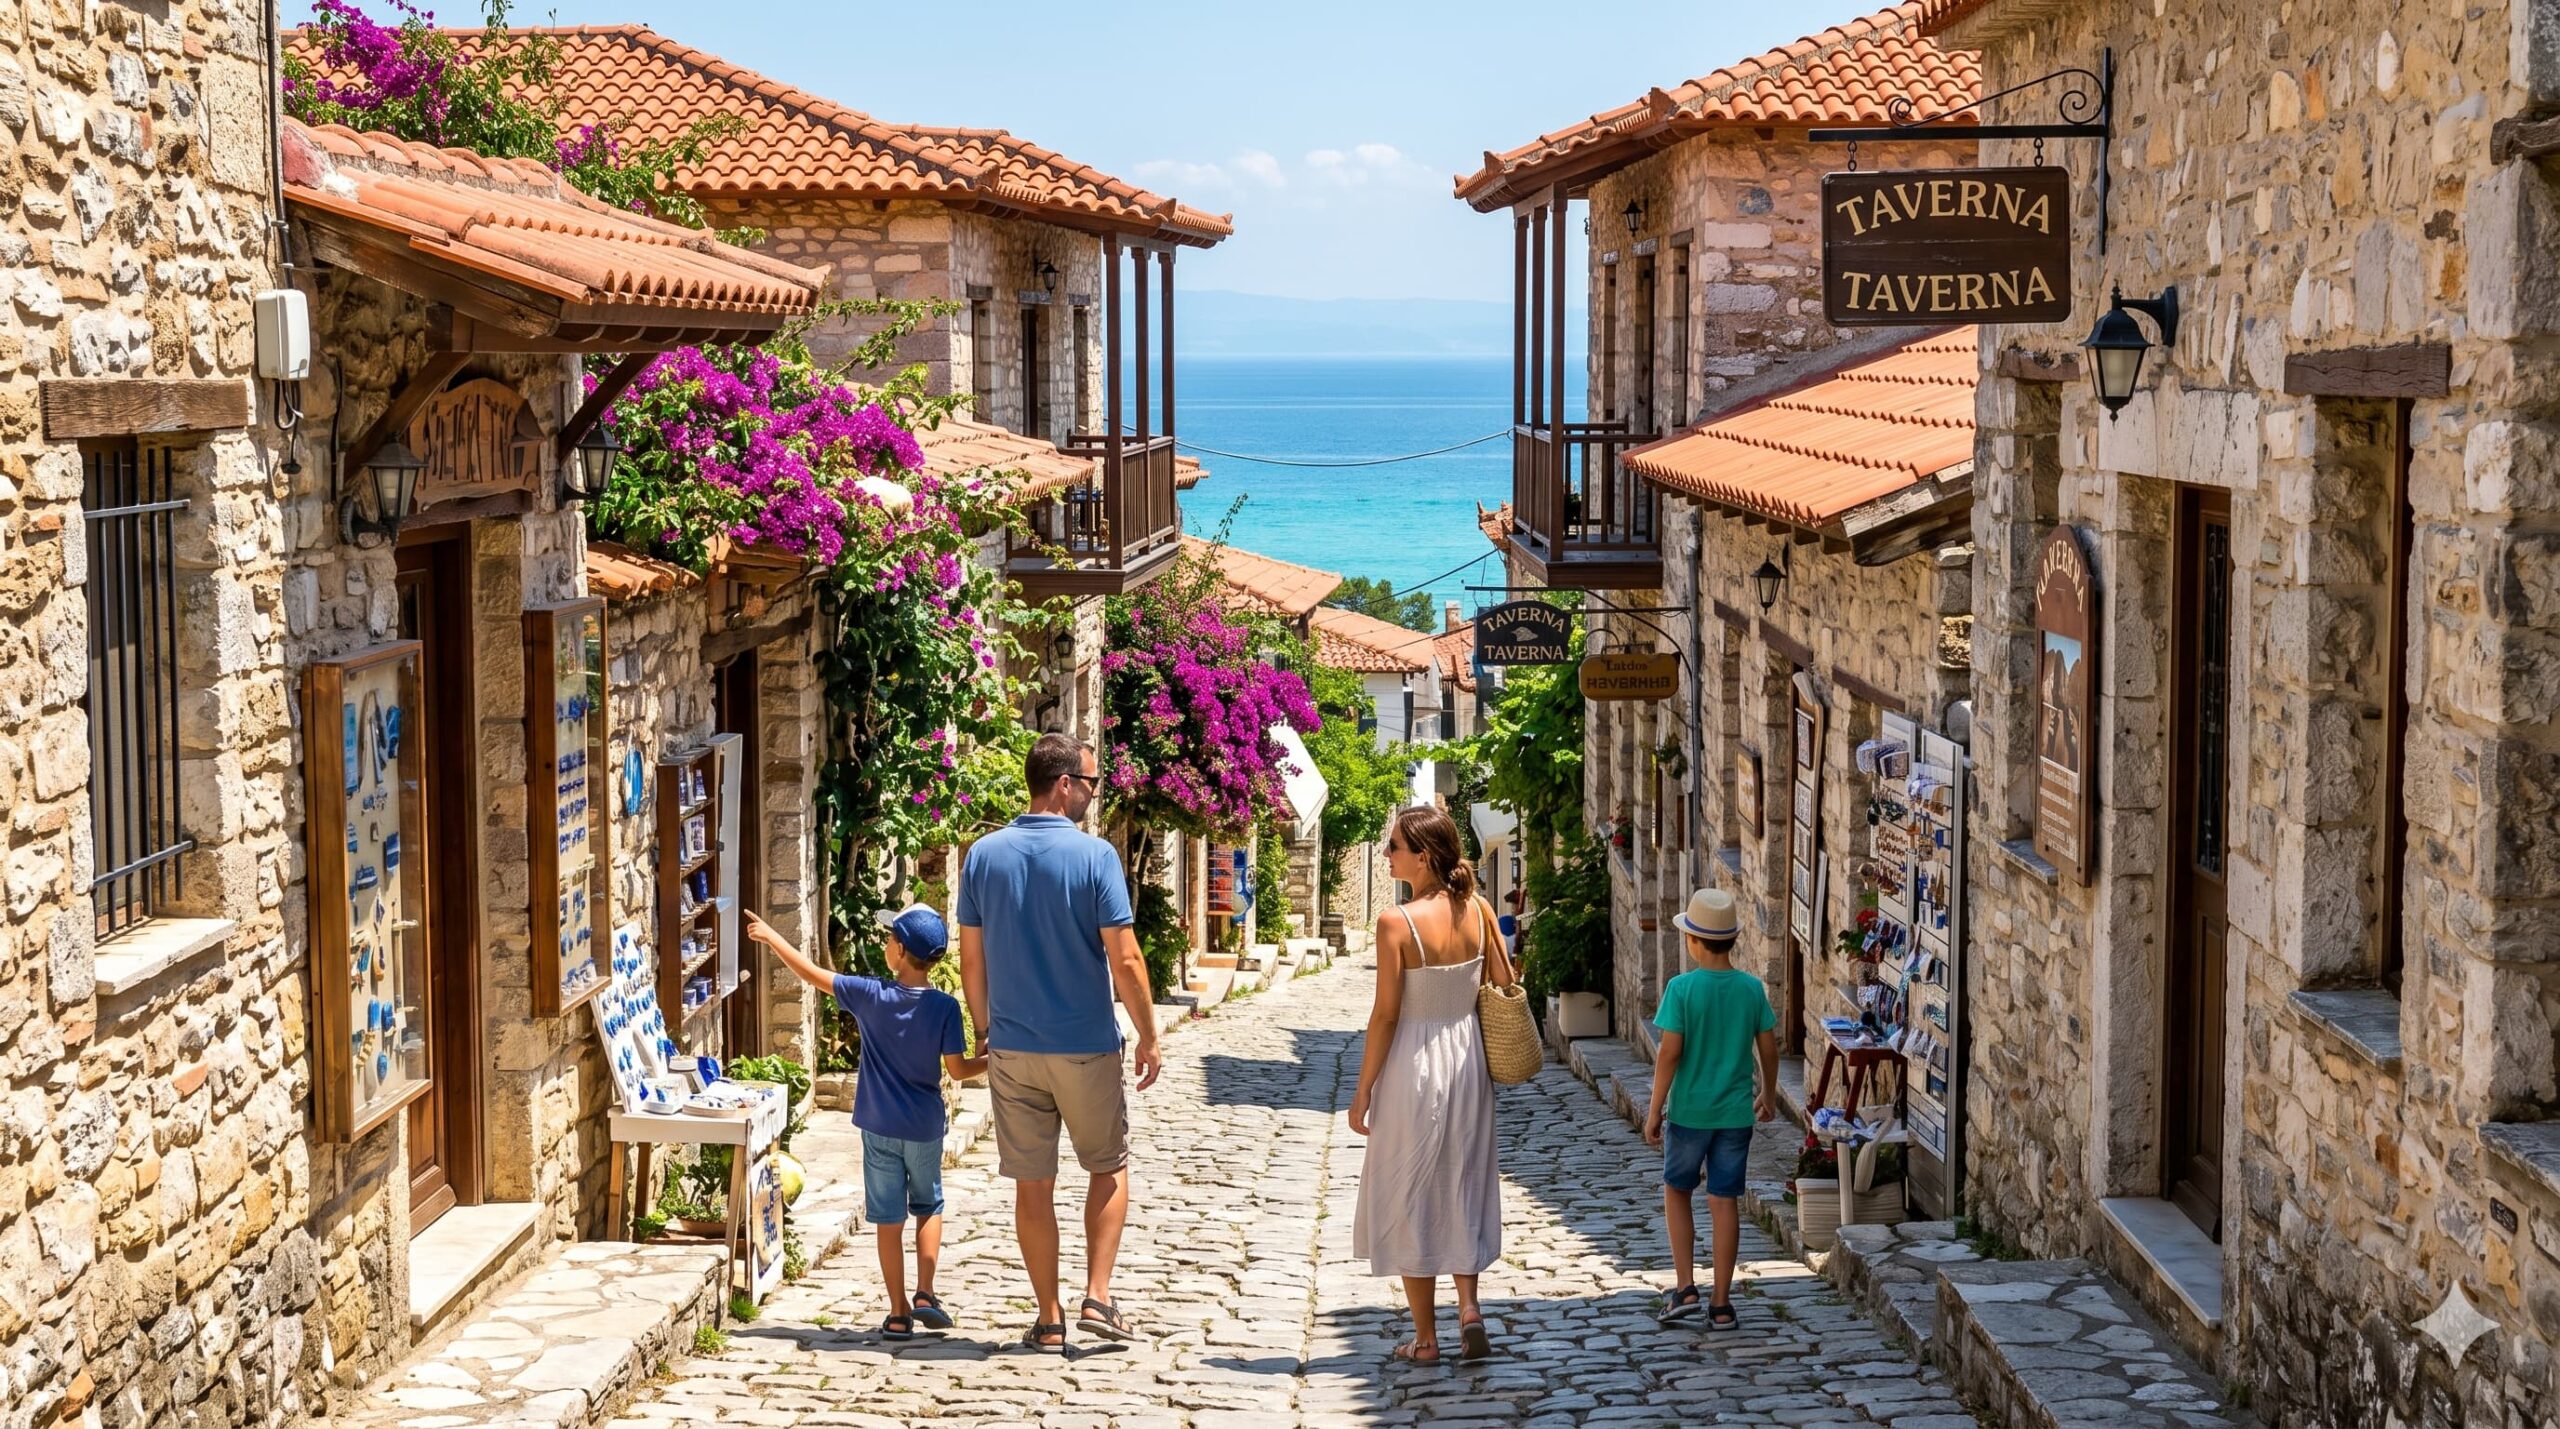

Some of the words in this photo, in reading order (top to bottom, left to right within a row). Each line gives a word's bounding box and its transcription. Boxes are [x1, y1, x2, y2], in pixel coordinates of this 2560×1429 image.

[1836, 180, 2051, 236] TAVERNA
[1842, 266, 2056, 312] TAVERNA
[1483, 607, 1565, 633] TAVERNA
[1484, 645, 1565, 660] TAVERNA
